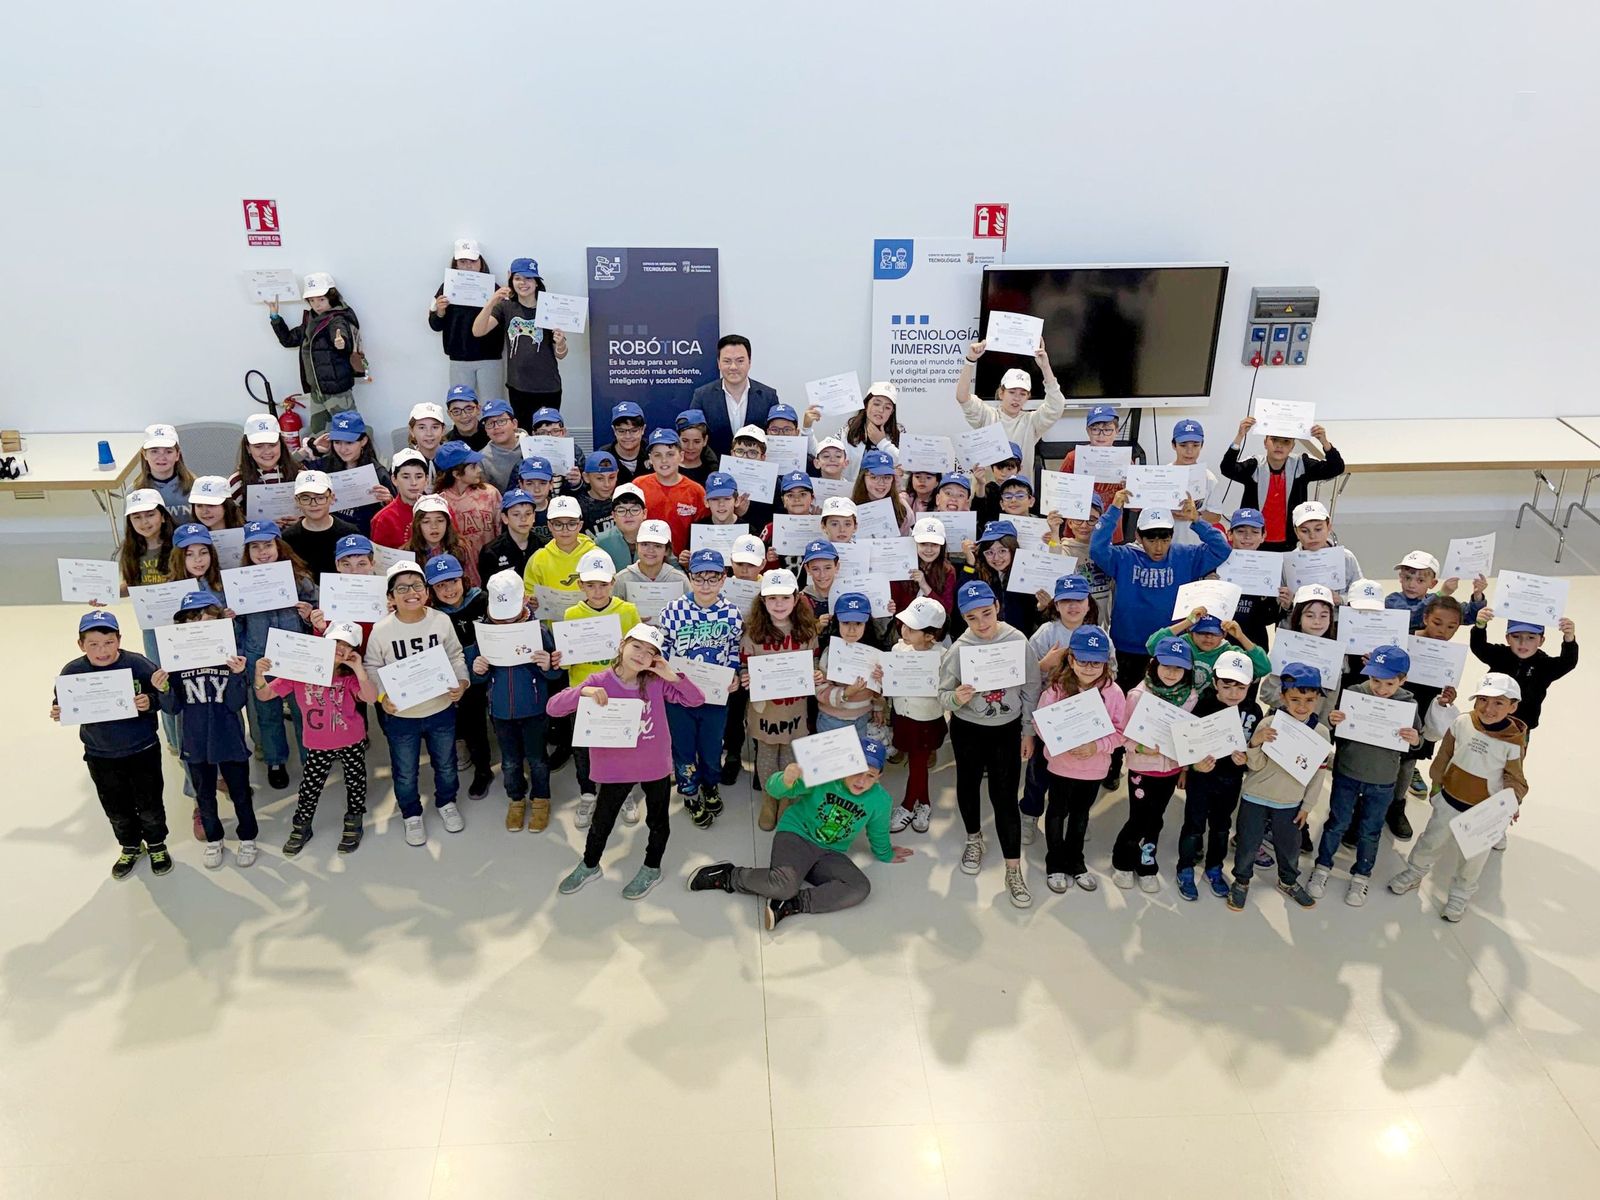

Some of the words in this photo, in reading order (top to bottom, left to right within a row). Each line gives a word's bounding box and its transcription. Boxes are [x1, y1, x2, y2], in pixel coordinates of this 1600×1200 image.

[891, 327, 980, 341] TECNOLOGÍA
[609, 337, 703, 355] ROBÓTICA
[891, 343, 962, 354] INMERSIVA
[609, 358, 617, 366] Es
[618, 358, 626, 366] la
[627, 358, 646, 366] clave
[647, 359, 663, 367] para
[890, 358, 918, 366] Fusiona
[919, 358, 927, 366] el
[928, 358, 955, 366] mundo
[609, 367, 650, 376] producción
[651, 367, 667, 375] más
[668, 367, 702, 376] eficiente,
[896, 367, 904, 375] el
[904, 367, 928, 376] digital
[609, 377, 648, 385] inteligente
[889, 378, 937, 386] experiencias
[1131, 564, 1174, 588] PORTO
[391, 633, 439, 661] USA
[181, 670, 196, 678] CITY
[759, 716, 802, 735] HAPPY
[825, 792, 867, 820] BOOM!
